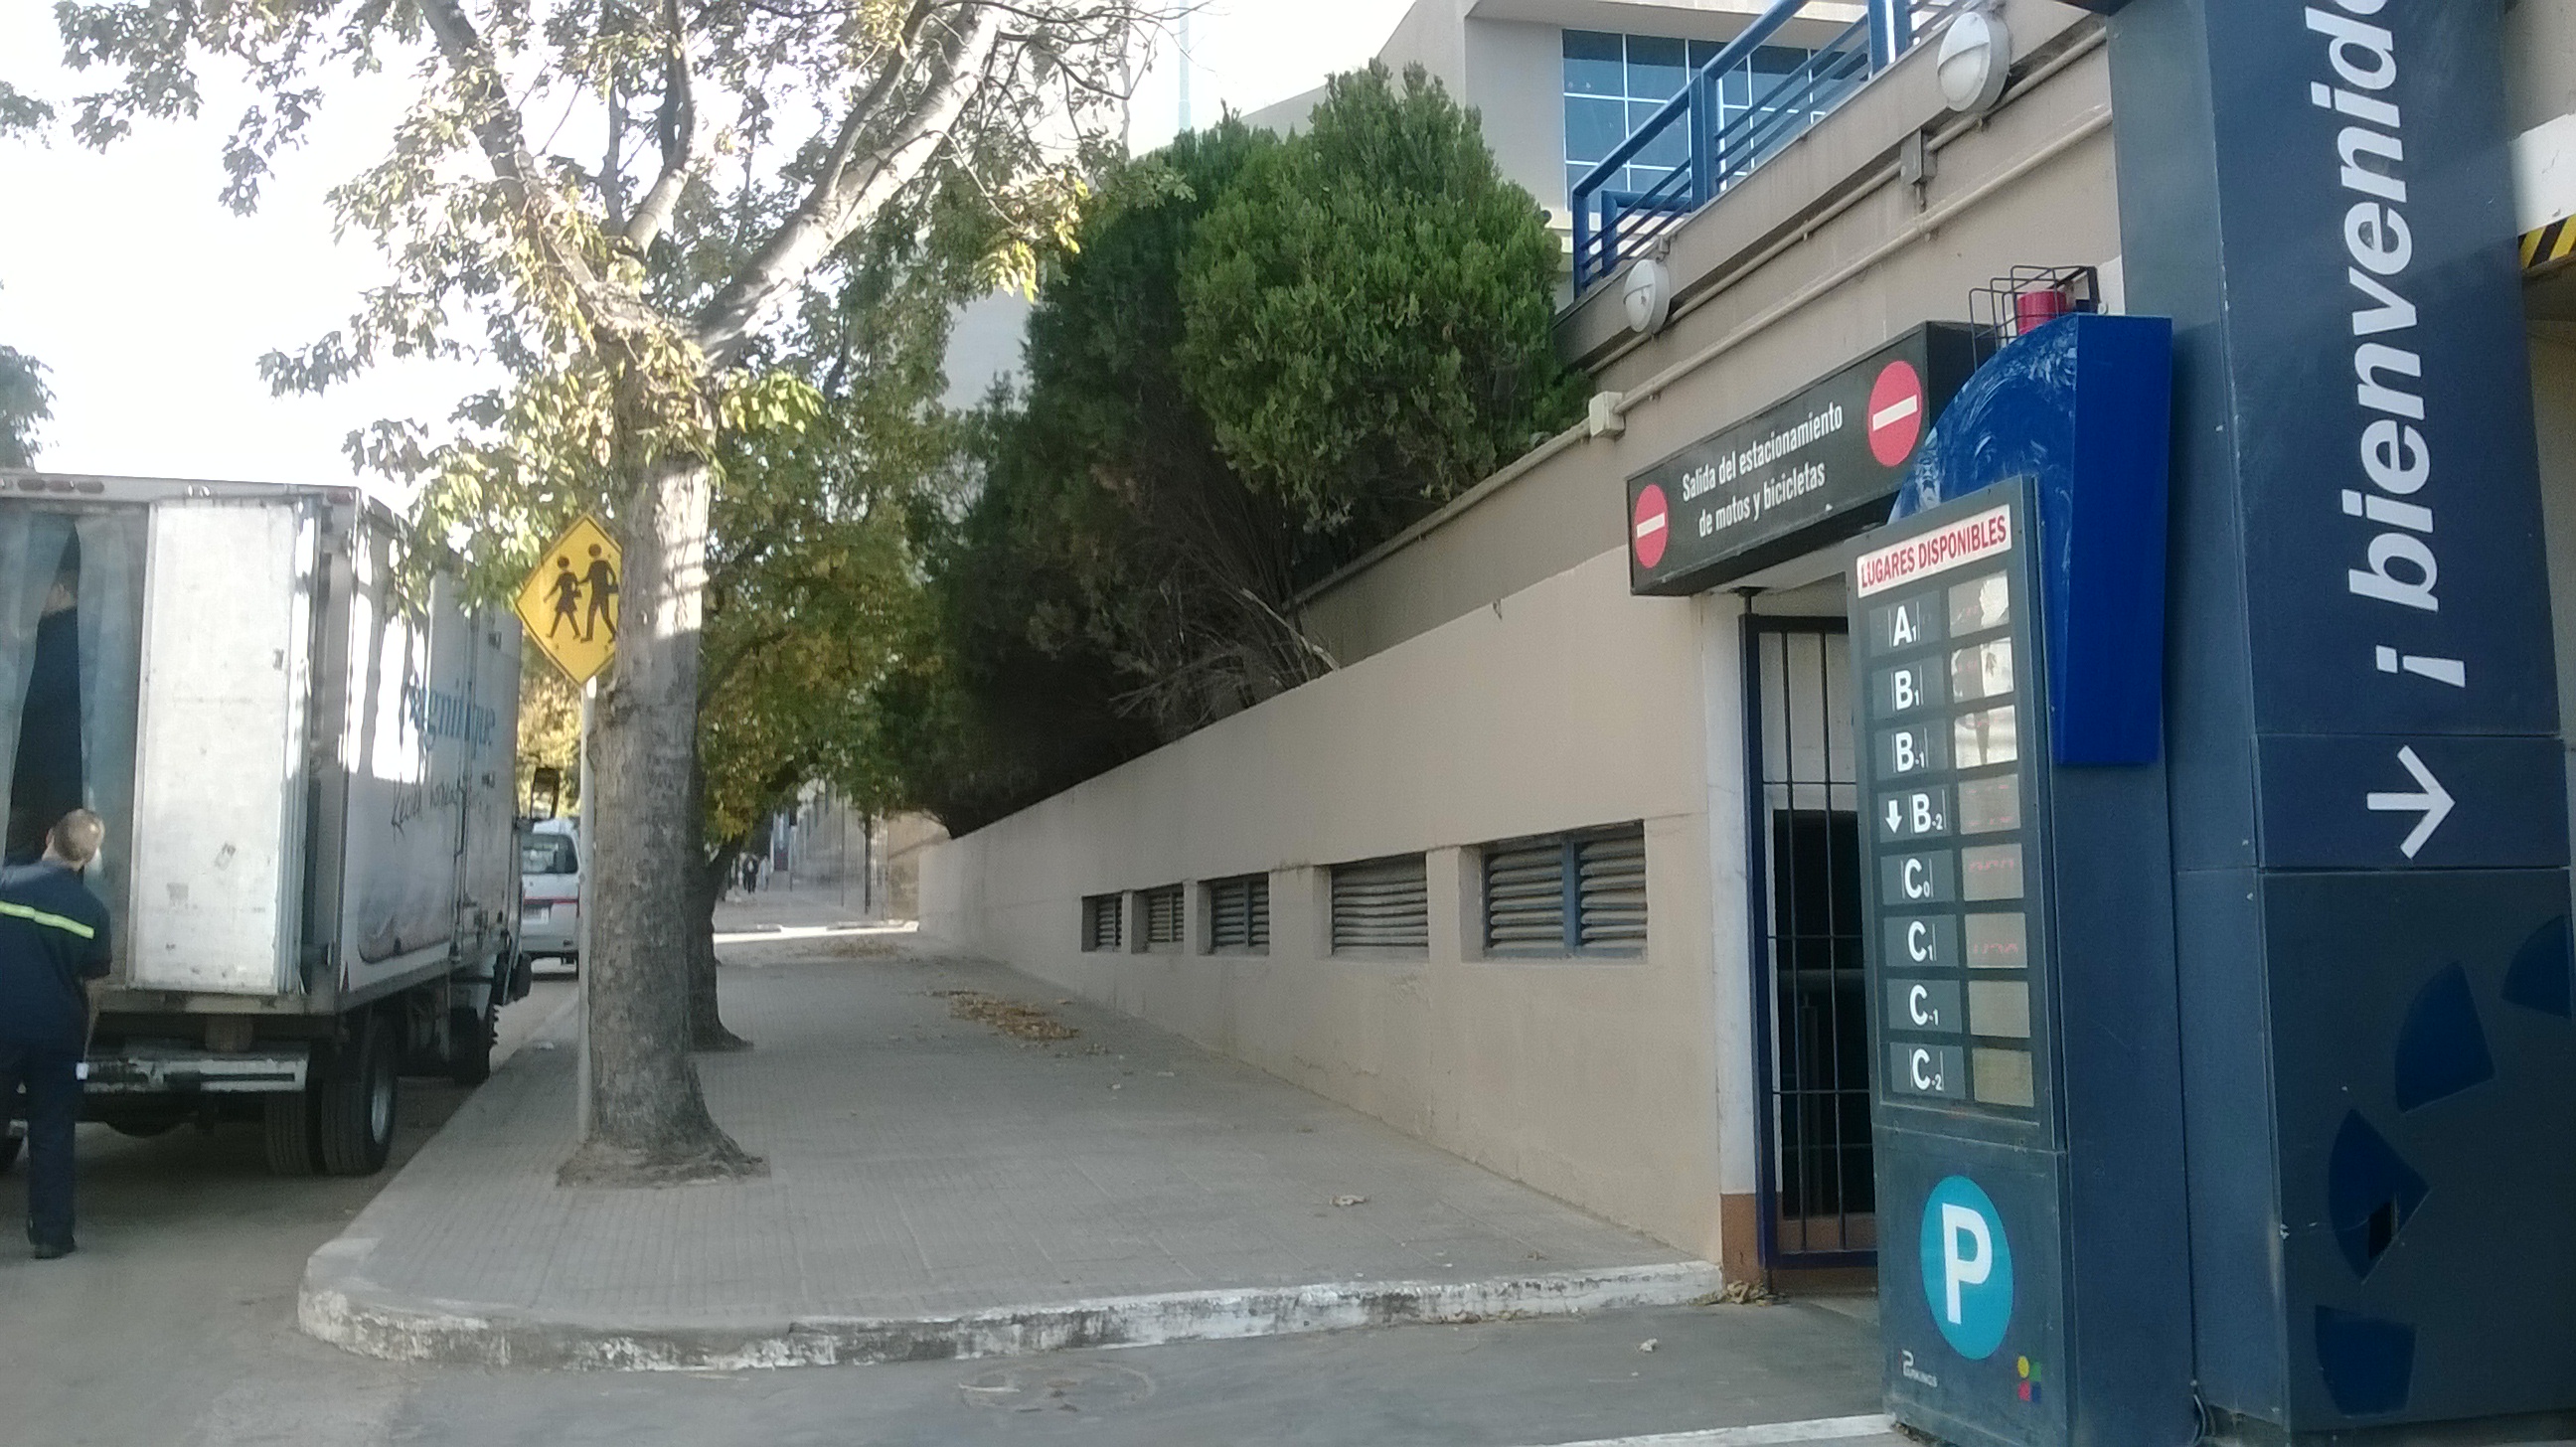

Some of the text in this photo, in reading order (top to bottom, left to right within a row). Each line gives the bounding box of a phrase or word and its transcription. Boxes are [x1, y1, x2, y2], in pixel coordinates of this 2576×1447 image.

[2305, 0, 2440, 612] bienvenid
[1682, 402, 1843, 502] Salida del estacionamiento
[1698, 461, 1826, 538] de motos y bicicletas
[1860, 515, 2007, 588] LUGARES DISPONIBLES
[1942, 1203, 1994, 1325] P
